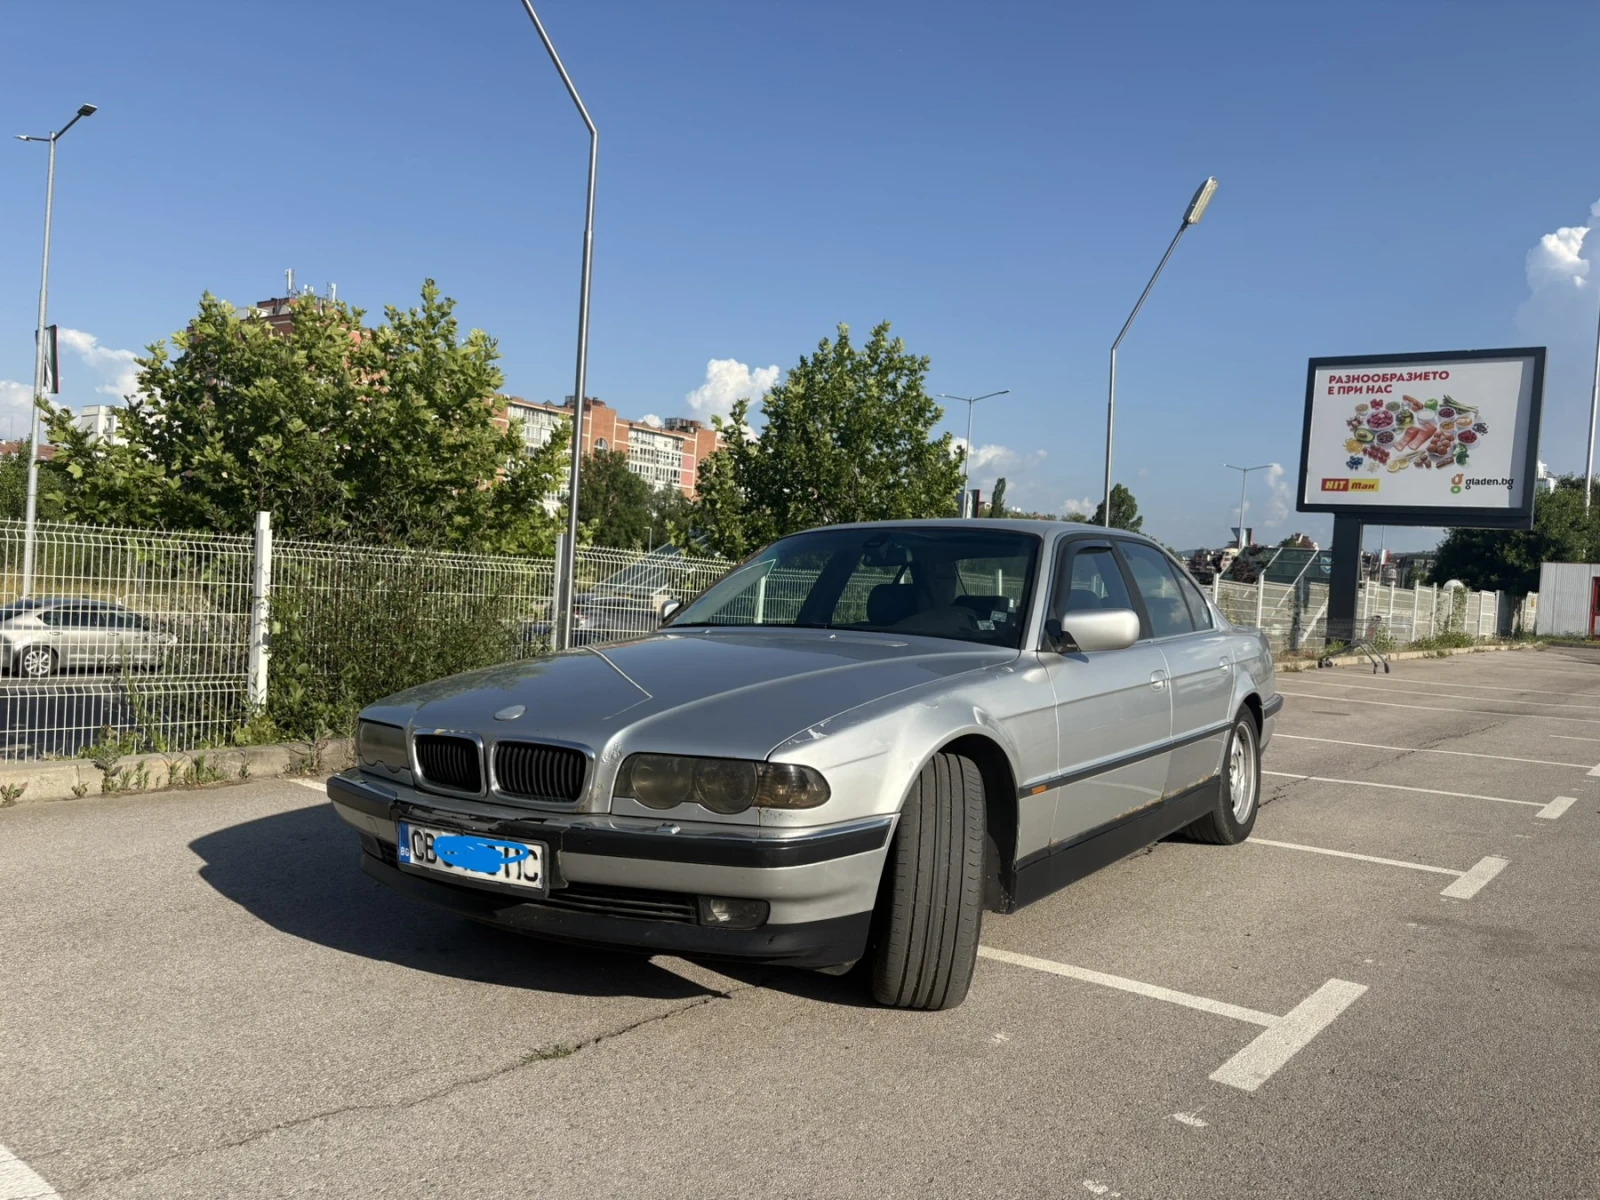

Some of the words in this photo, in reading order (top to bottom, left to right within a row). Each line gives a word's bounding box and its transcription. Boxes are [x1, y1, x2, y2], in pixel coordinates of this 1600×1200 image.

[1329, 370, 1450, 384] РАЗНООБРАЗИЕТО
[1327, 386, 1335, 395] Е
[1337, 385, 1363, 395] ПРИ
[1366, 384, 1393, 394] НАС
[1325, 480, 1347, 490] HIT
[1465, 477, 1515, 491] gladen.bg
[400, 846, 410, 857] BG
